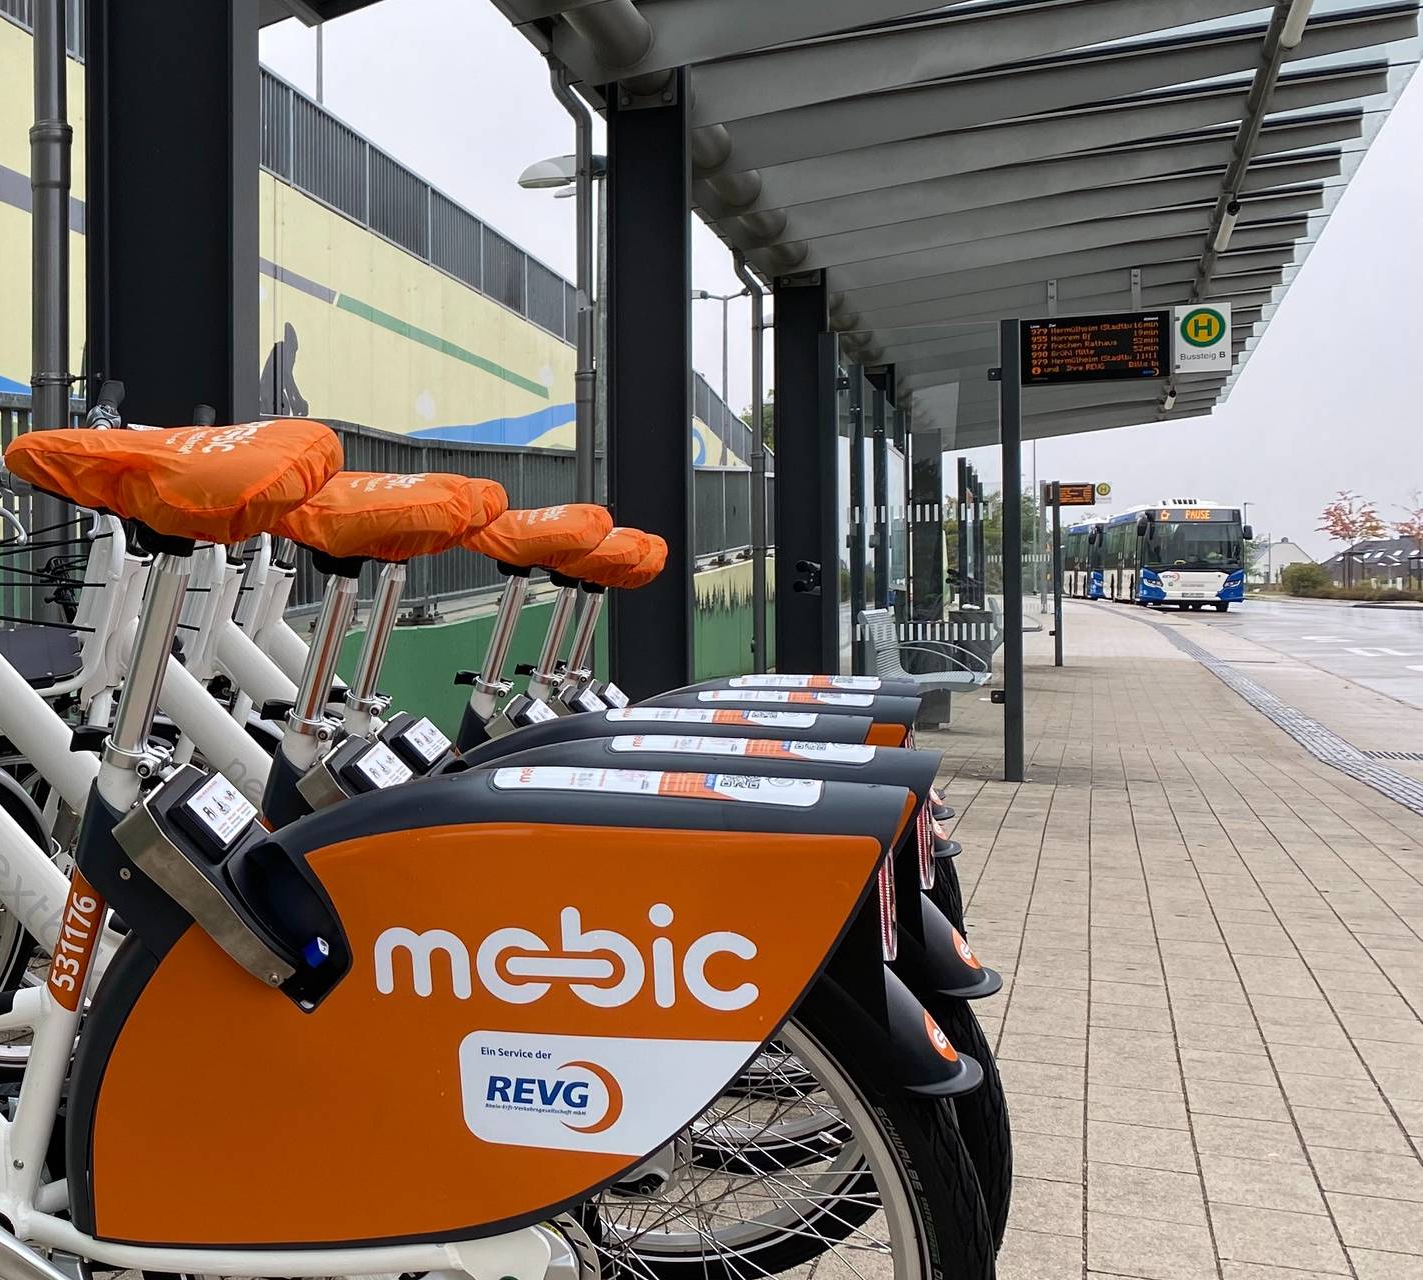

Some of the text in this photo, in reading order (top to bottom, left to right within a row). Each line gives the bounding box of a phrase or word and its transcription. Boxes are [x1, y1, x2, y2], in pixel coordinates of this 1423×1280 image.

[1194, 319, 1212, 337] H
[1180, 352, 1217, 360] Bussteig
[1185, 509, 1211, 519] PAUSE
[51, 892, 97, 992] 531176
[374, 903, 760, 1011] mobic
[481, 1046, 552, 1059] Ein Service der
[486, 1075, 589, 1108] REVG
[875, 1106, 923, 1192] SCHWALBE
